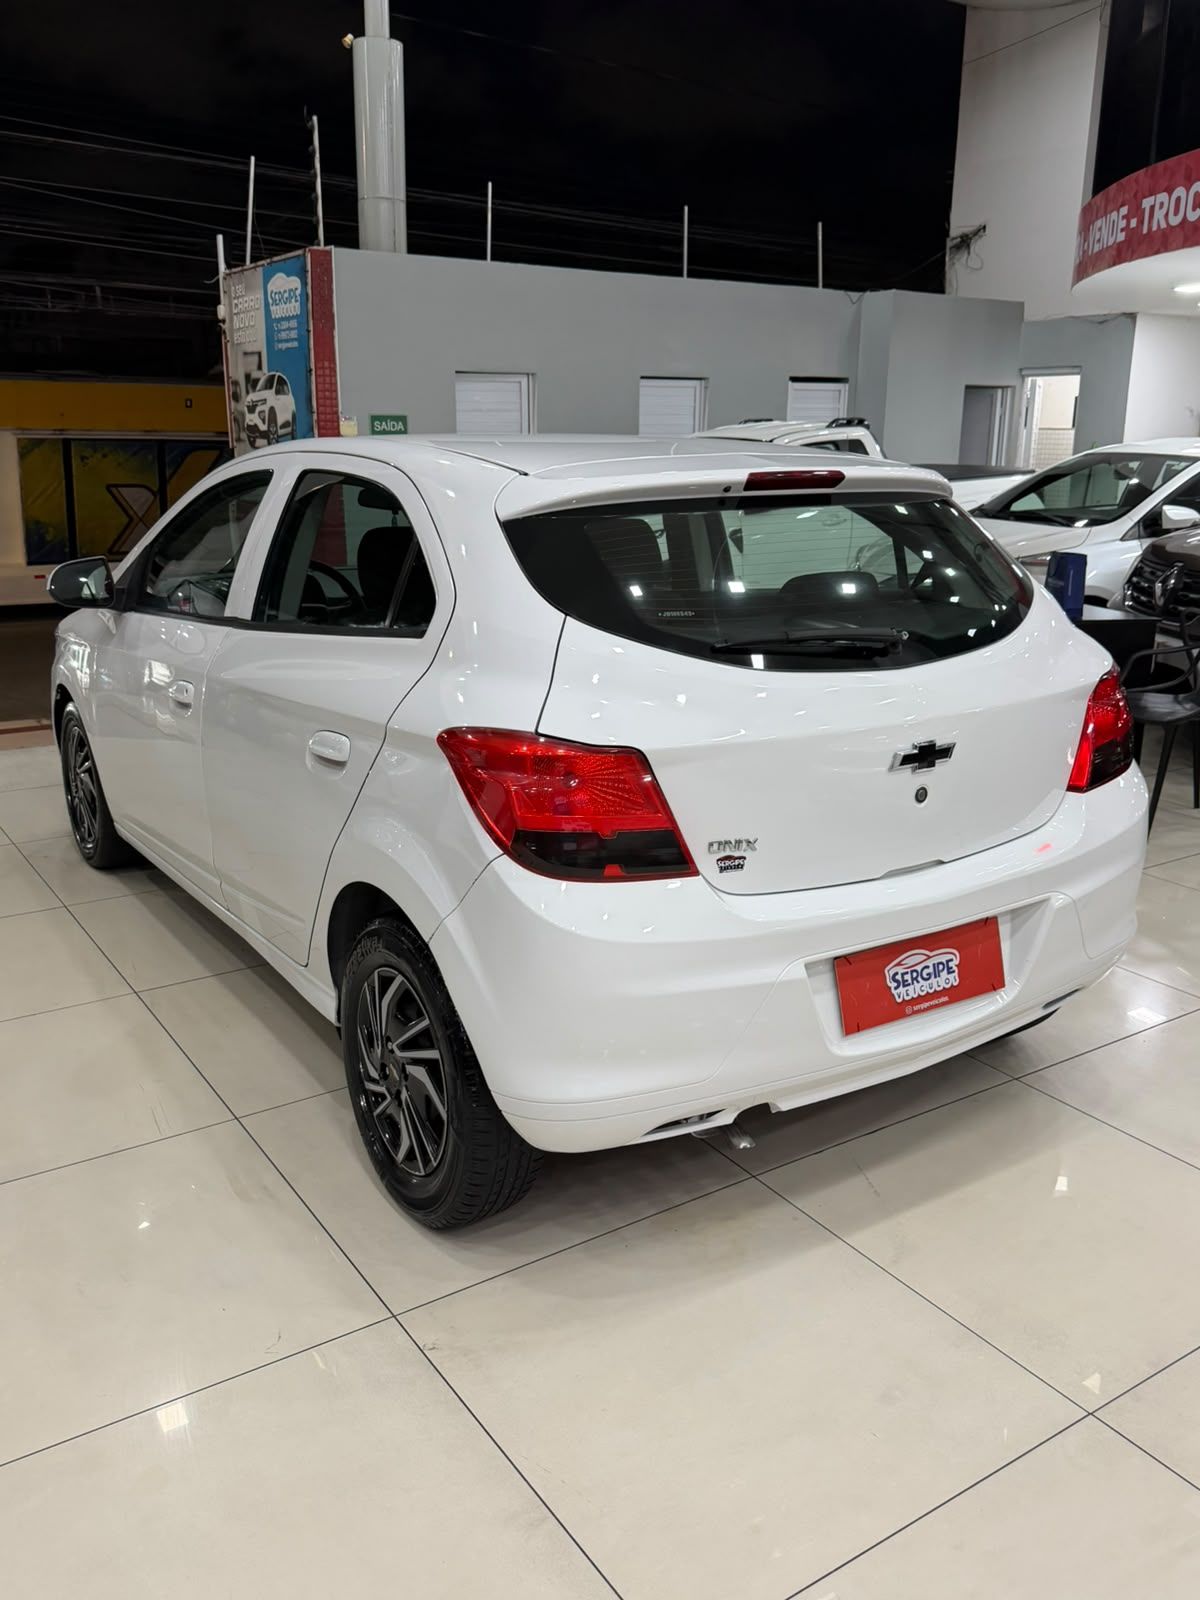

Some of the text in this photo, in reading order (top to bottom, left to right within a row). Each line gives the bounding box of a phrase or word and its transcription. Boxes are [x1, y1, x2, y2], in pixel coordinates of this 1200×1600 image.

[1089, 205, 1129, 256] VENDE
[1142, 181, 1200, 235] TROC
[233, 295, 260, 313] CARRO
[269, 287, 299, 306] SERGIPE
[233, 312, 255, 329] NOVO
[374, 419, 405, 431] SAÍDA
[708, 838, 758, 854] ONIX
[890, 958, 956, 991] SERGIPE
[896, 976, 958, 998] VEÍCULOS
